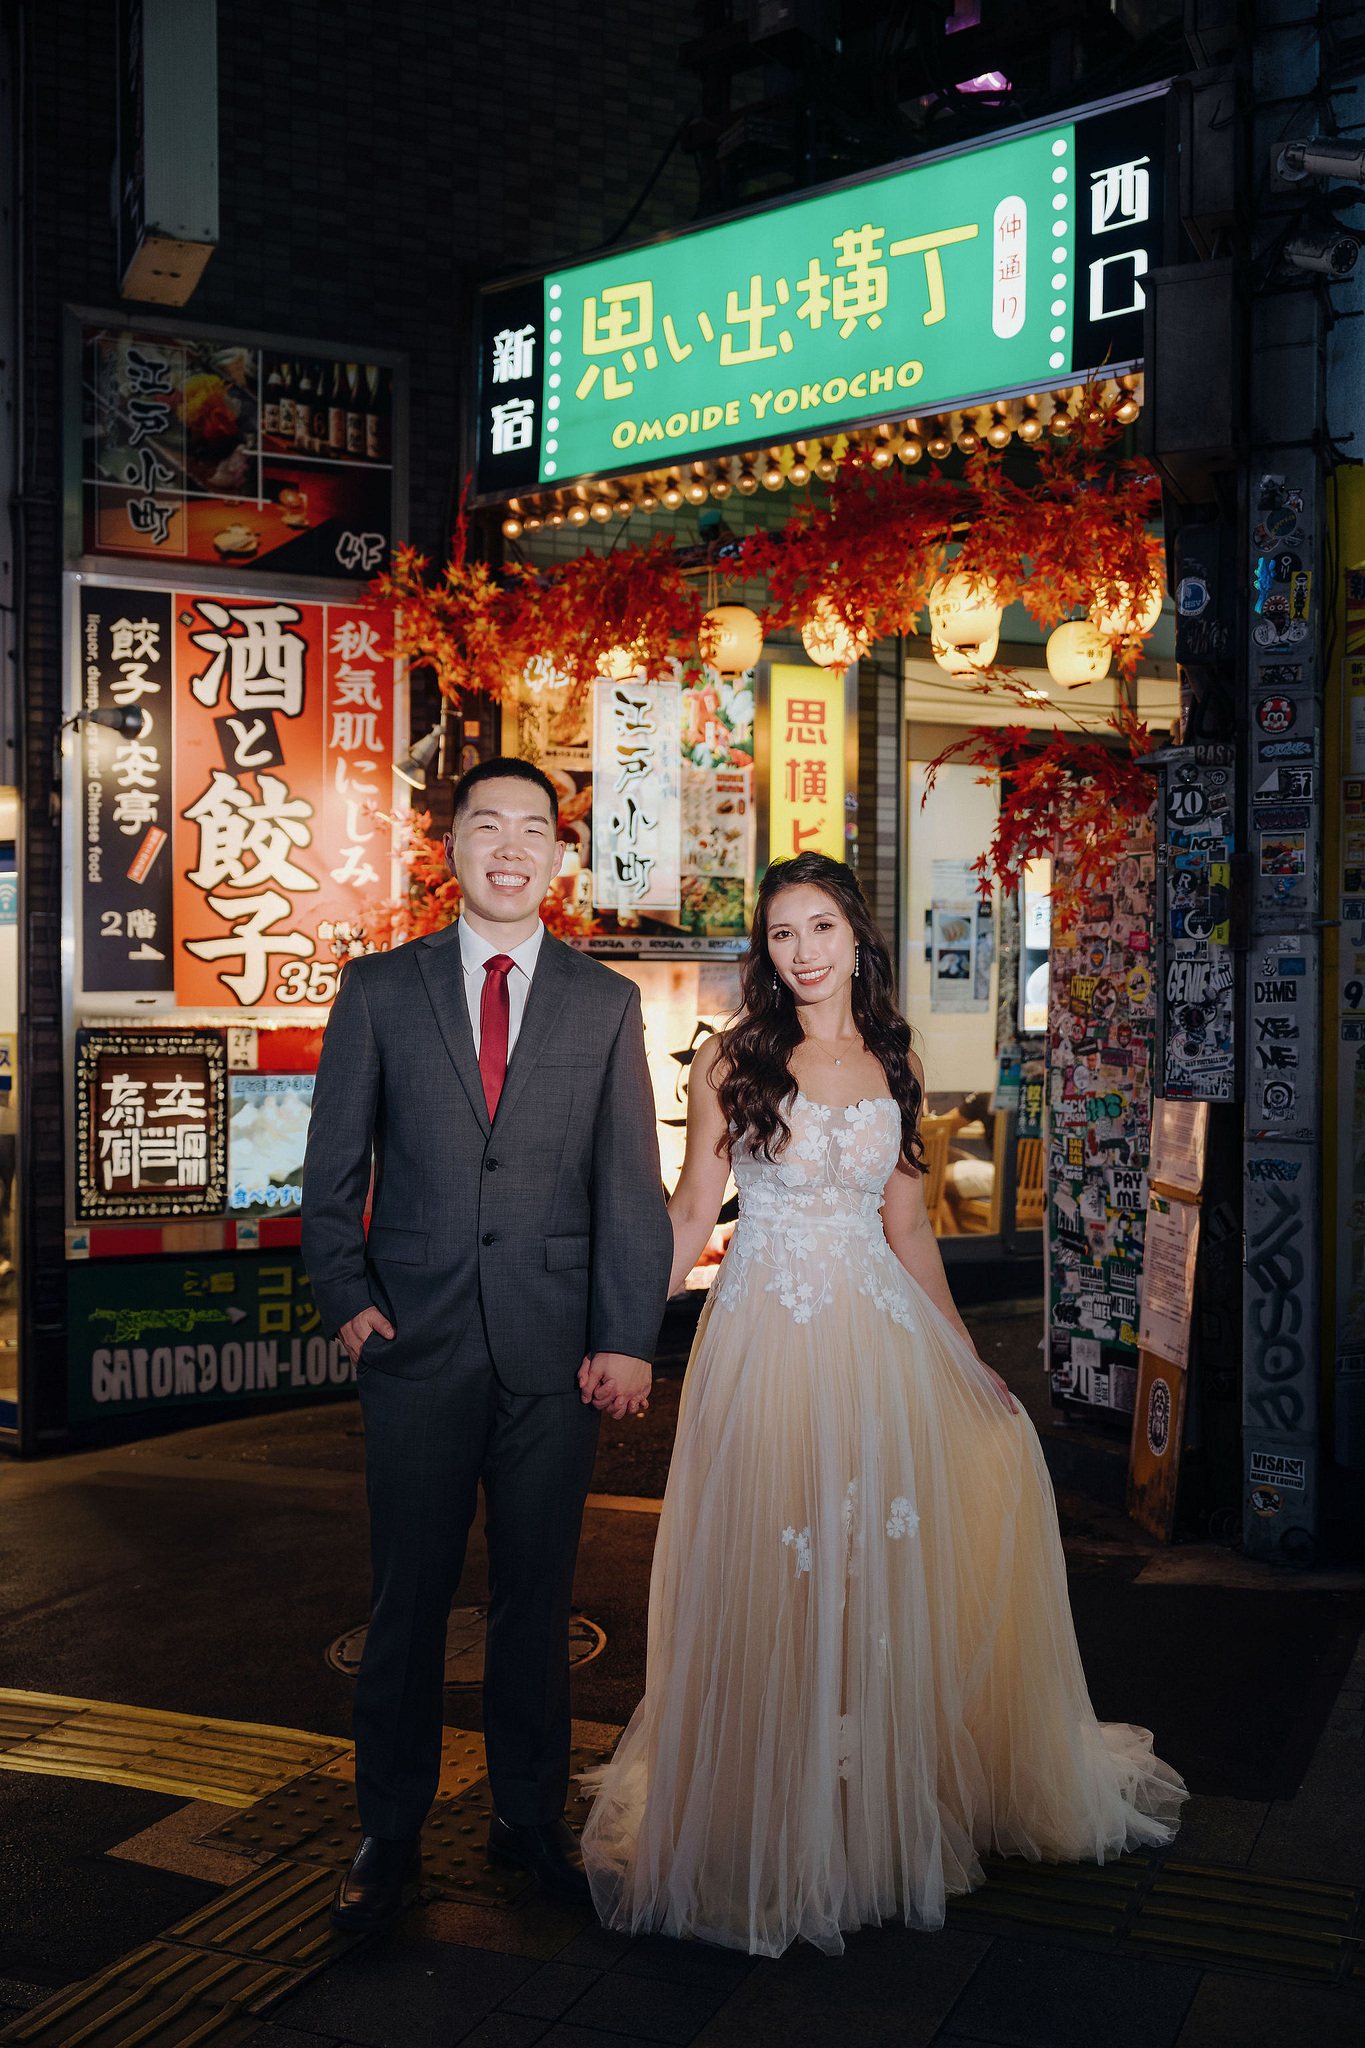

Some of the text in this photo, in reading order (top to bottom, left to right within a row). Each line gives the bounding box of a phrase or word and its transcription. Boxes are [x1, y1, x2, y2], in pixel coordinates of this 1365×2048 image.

[998, 212, 1023, 321] 仲通り
[1089, 155, 1151, 323] 西口
[574, 222, 980, 401] 思い出横丁
[489, 322, 538, 456] 新宿
[610, 359, 925, 450] OMOIDE YOKOCHO
[181, 599, 320, 1007] 酒と餃子
[784, 697, 830, 855] 思横ビ
[86, 780, 103, 844] Chinese
[87, 846, 103, 883] food
[100, 908, 158, 940] 2階
[274, 959, 342, 1006] 35
[1344, 980, 1363, 1010] 9
[234, 1033, 252, 1047] 2F
[1113, 1171, 1143, 1190] PAY
[1116, 1190, 1142, 1209] ME
